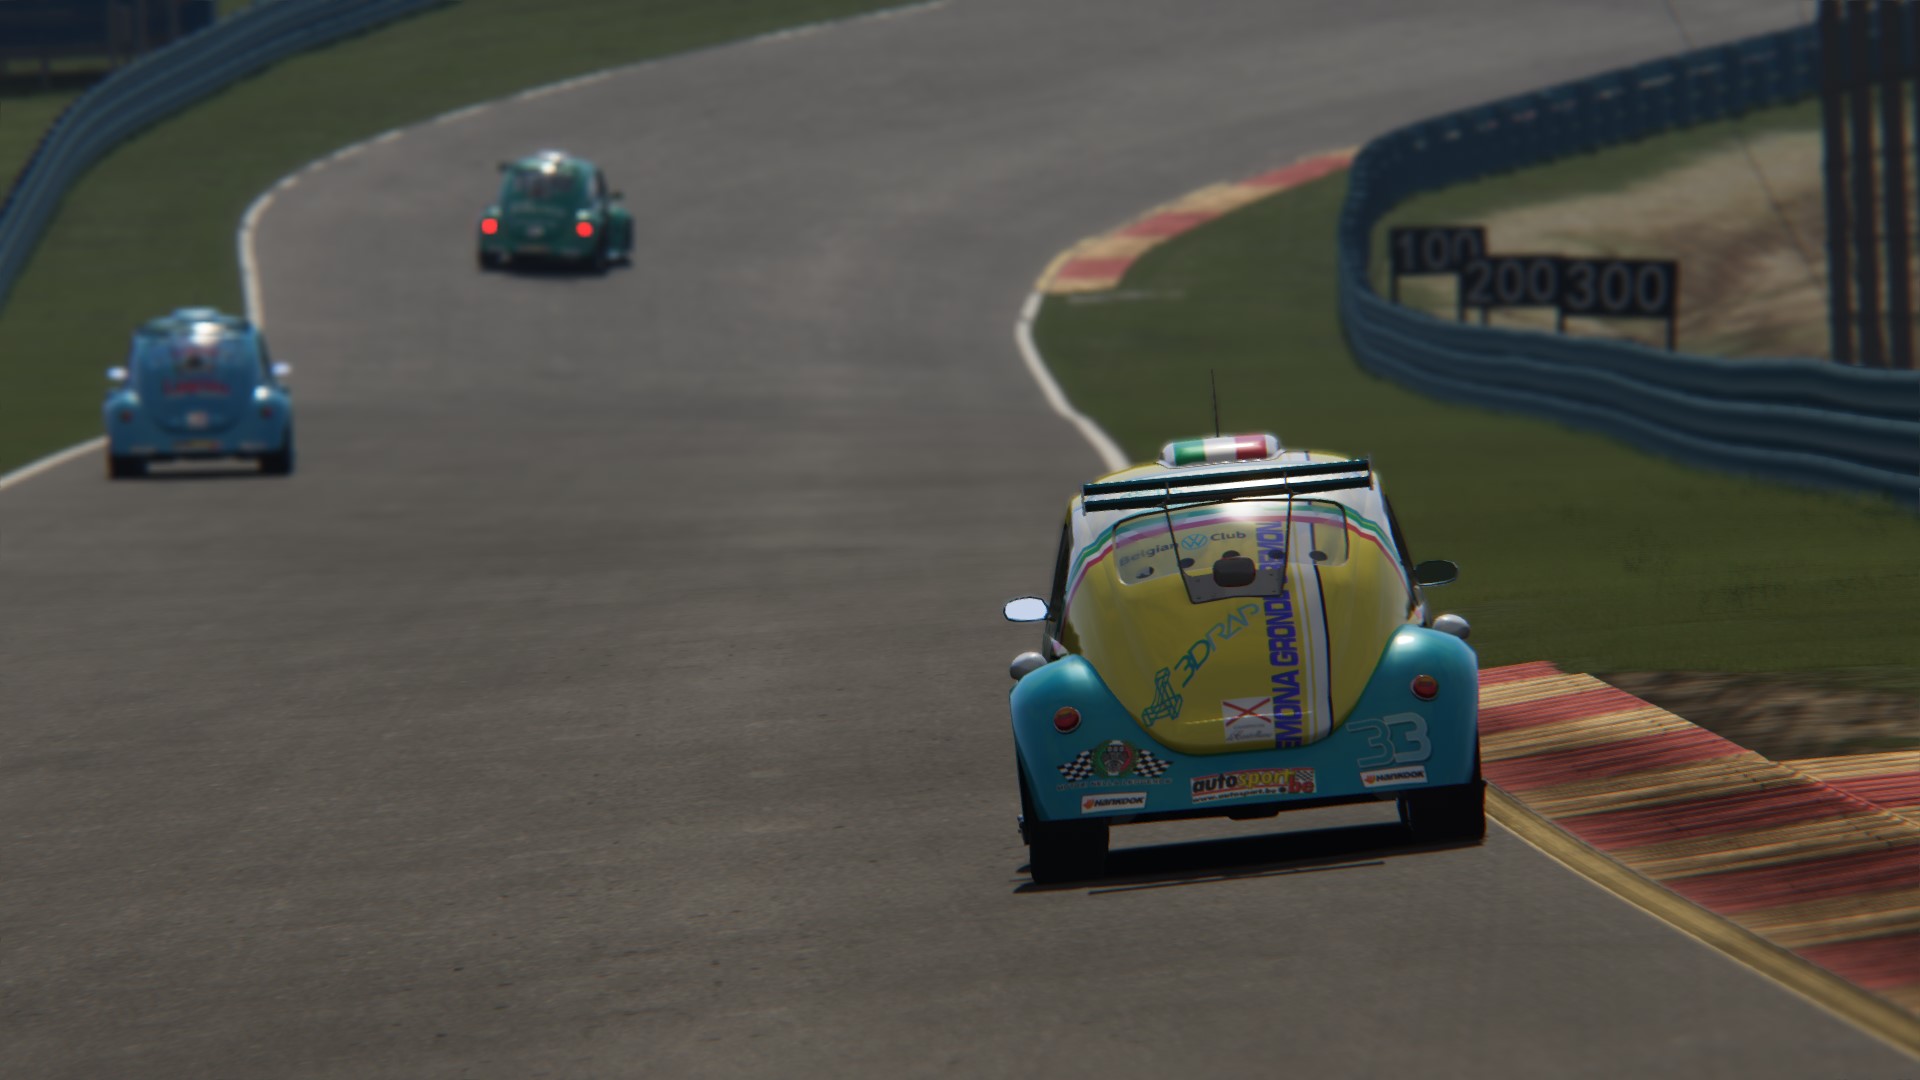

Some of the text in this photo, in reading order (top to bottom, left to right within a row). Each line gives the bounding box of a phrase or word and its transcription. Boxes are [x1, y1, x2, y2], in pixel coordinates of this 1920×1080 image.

[1398, 230, 1478, 270] 100
[1466, 259, 1557, 304] 200
[1565, 261, 1667, 312] 300
[1119, 542, 1179, 567] Belgian
[1210, 531, 1247, 542] Club
[1174, 603, 1260, 688] 3DRAP
[1346, 712, 1431, 768] 33
